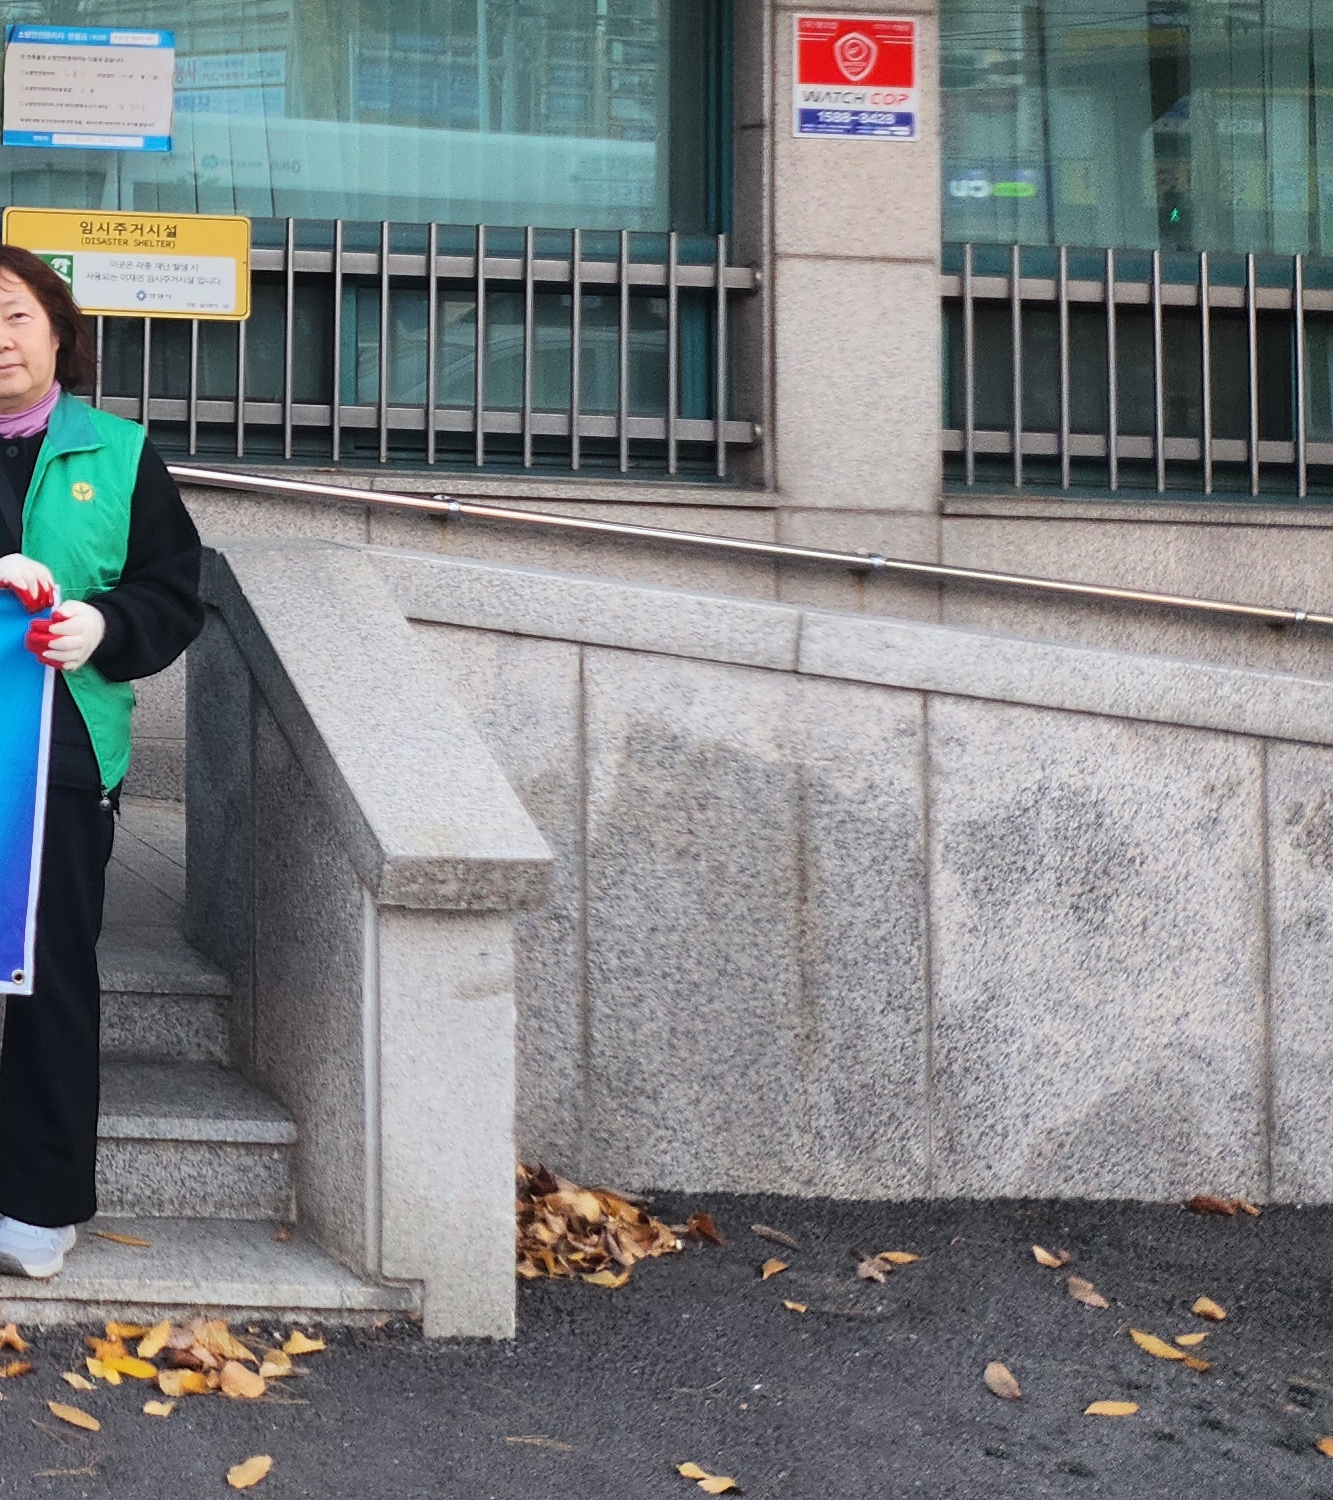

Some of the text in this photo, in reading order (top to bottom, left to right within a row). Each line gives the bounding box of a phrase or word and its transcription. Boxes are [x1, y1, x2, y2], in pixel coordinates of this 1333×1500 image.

[802, 90, 910, 106] WATCH COP
[80, 221, 178, 239] 임시주거시설
[81, 237, 176, 249] (DISASTER SHELTER)
